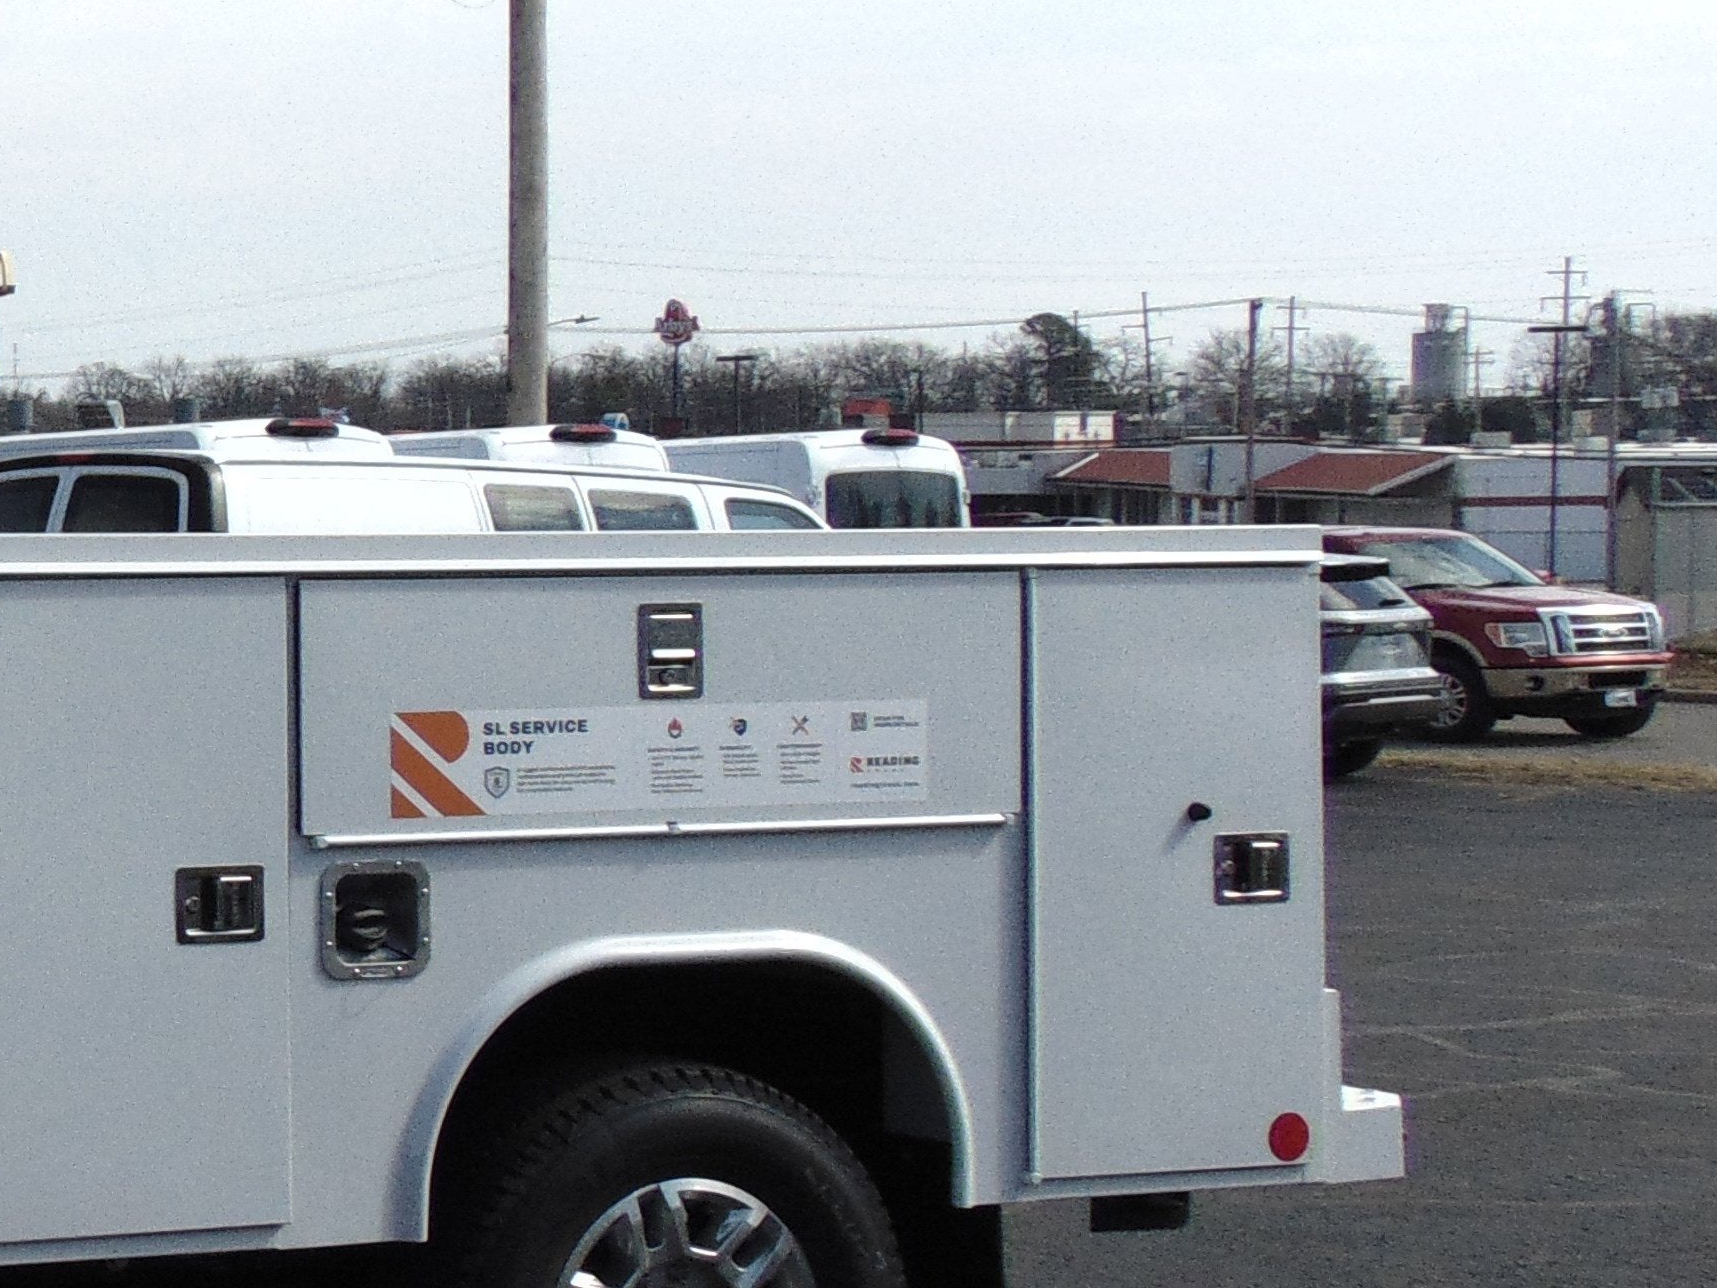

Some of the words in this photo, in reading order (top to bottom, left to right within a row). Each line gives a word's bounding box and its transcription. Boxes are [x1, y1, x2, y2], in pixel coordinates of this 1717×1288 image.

[483, 721, 506, 736] SL
[509, 719, 589, 735] SERVICE
[483, 740, 534, 755] BODY
